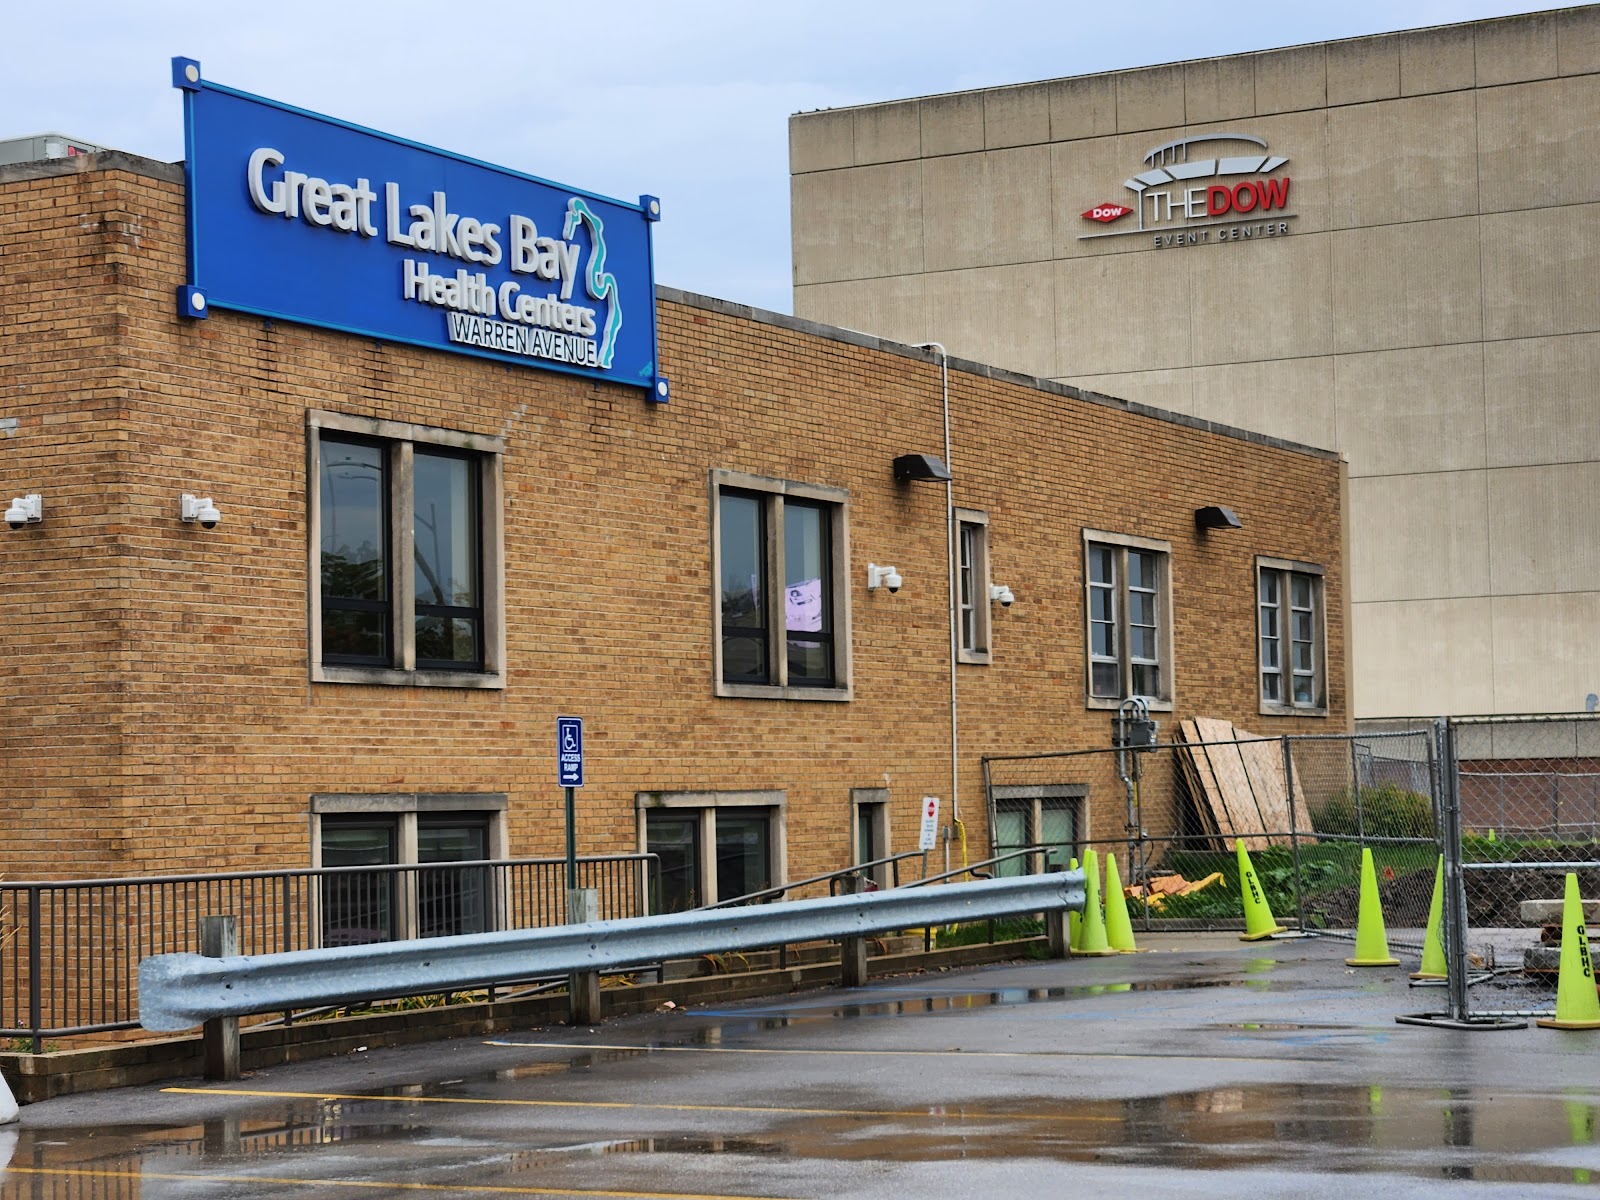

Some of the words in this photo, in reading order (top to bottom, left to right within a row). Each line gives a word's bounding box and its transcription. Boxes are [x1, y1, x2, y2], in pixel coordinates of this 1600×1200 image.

[1092, 207, 1122, 218] DOW
[1207, 177, 1290, 216] DOW
[247, 148, 378, 238] Great
[386, 182, 502, 266] Lakes
[509, 214, 581, 300] Bay
[1154, 231, 1208, 247] EVENT
[1218, 222, 1288, 240] CENTER
[403, 259, 497, 317] Health
[498, 281, 597, 337] Centers
[449, 312, 528, 354] WARREN
[531, 329, 597, 366] AVENUE
[561, 753, 581, 762] ACCESS
[1577, 925, 1591, 977] GLBHC
